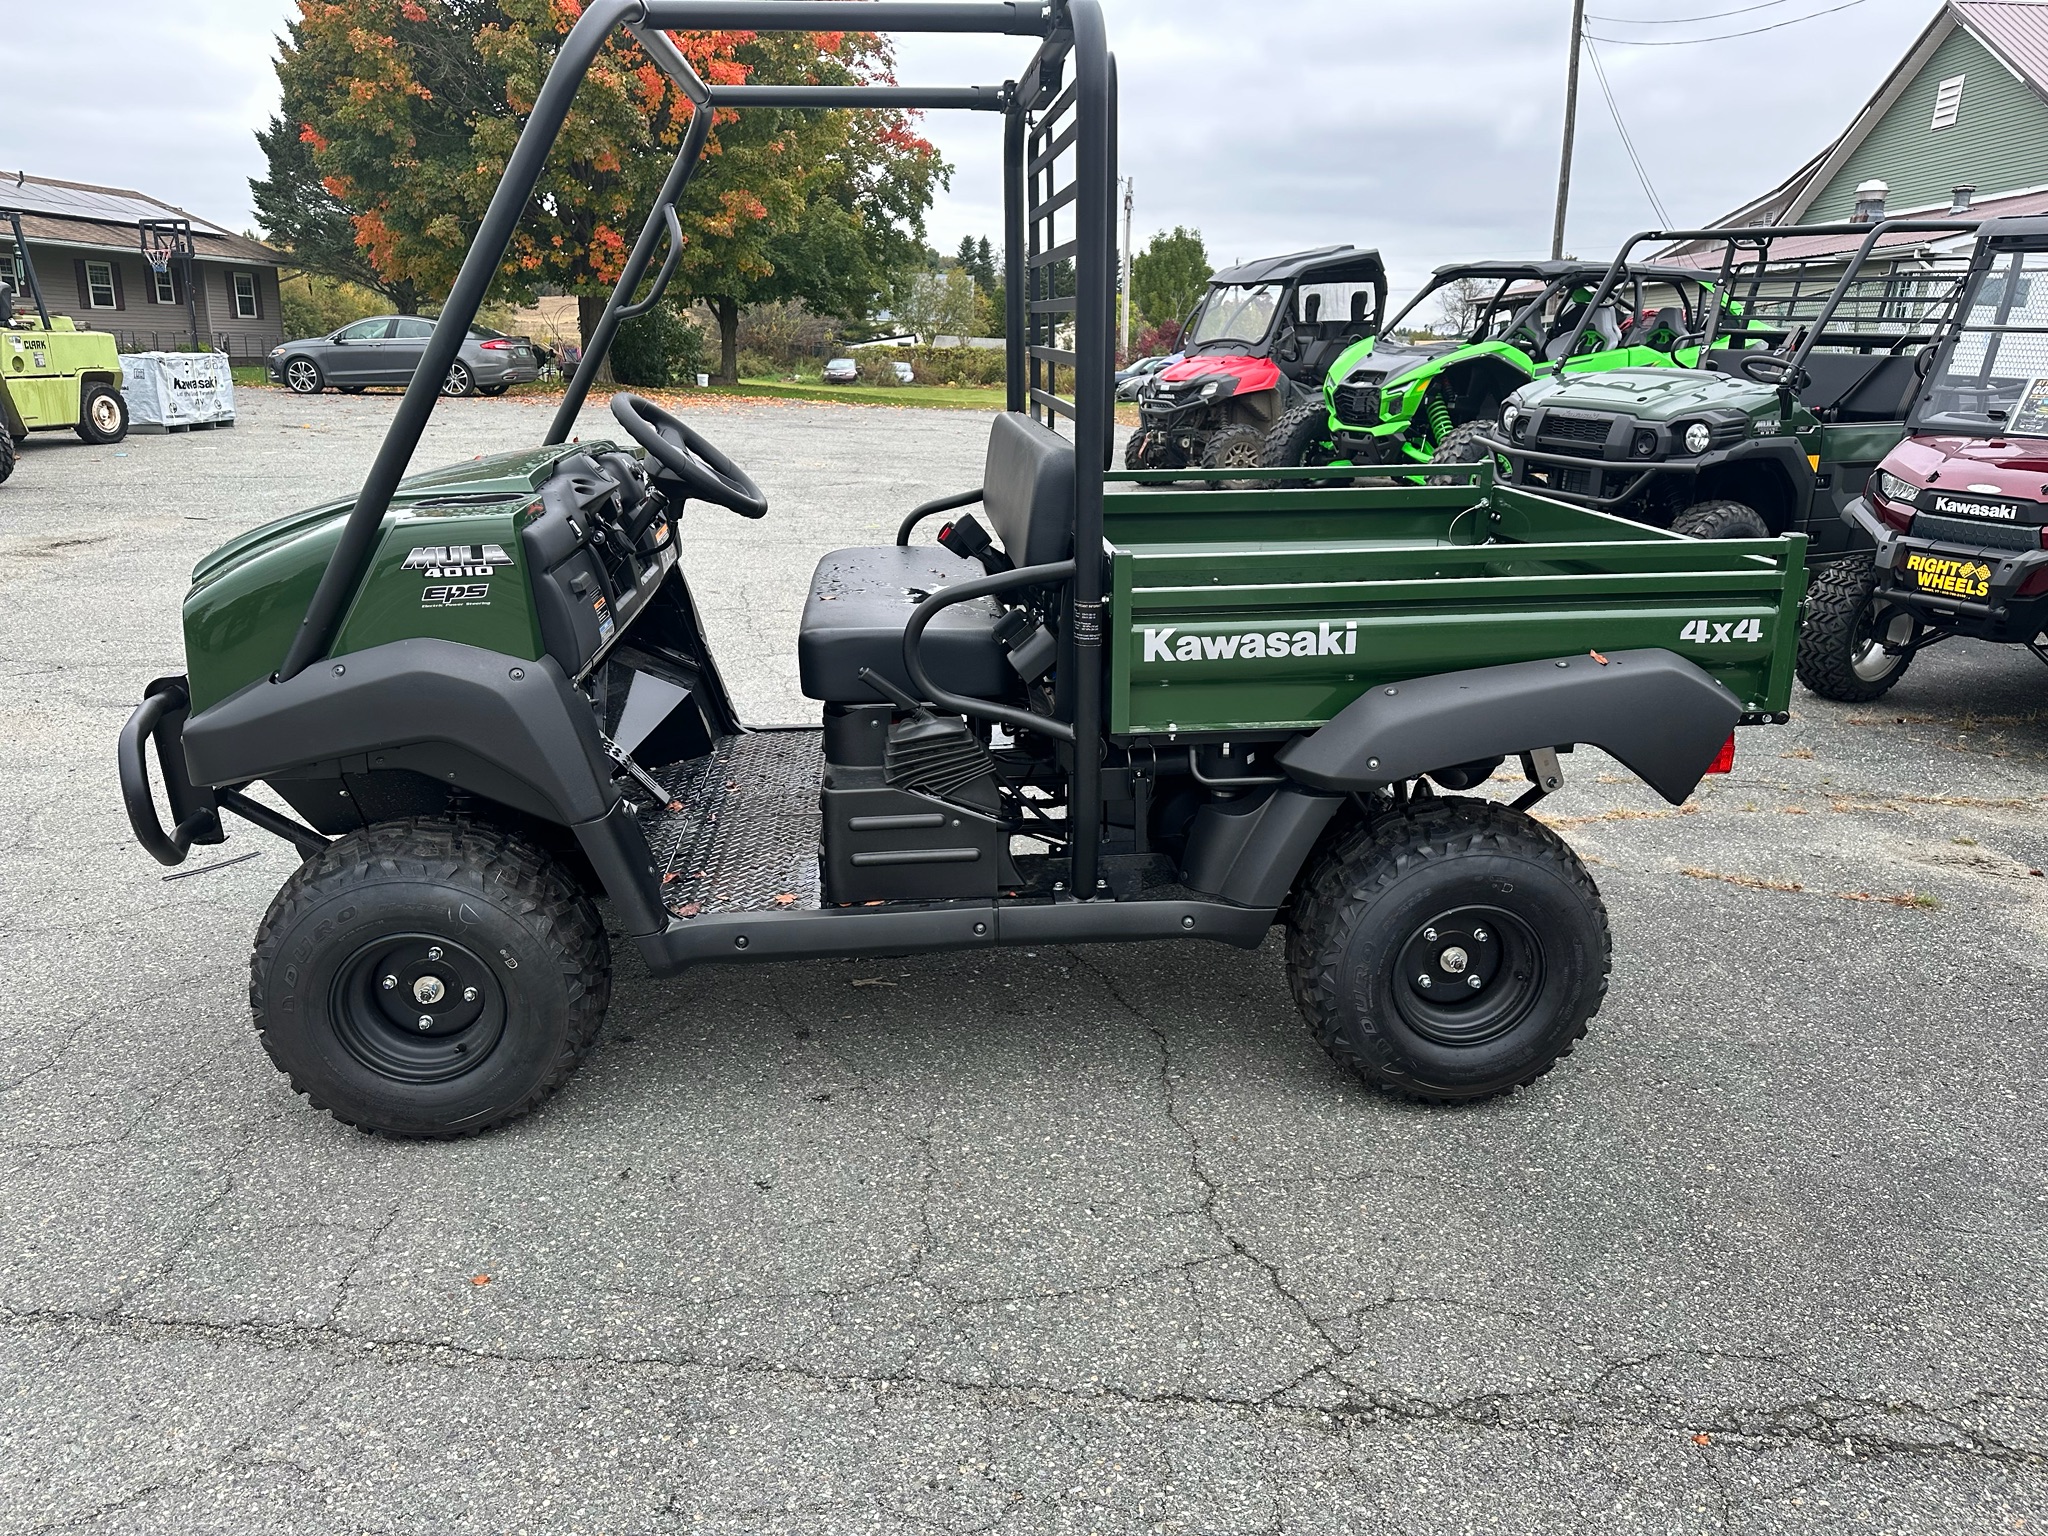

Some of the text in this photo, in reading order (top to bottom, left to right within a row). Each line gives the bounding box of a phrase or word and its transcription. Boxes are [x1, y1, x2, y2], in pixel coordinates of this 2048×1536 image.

[23, 340, 46, 350] CLARK
[173, 375, 218, 390] Kawasaki
[1935, 497, 2018, 520] Kawasaki
[400, 544, 515, 570] MULE
[1906, 555, 1961, 577] RIGHT
[424, 566, 494, 577] 4010
[1917, 572, 1989, 597] WHEELS
[1143, 621, 1357, 662] Kawasaki
[1680, 619, 1763, 643] 4x4
[284, 904, 358, 989] DURO
